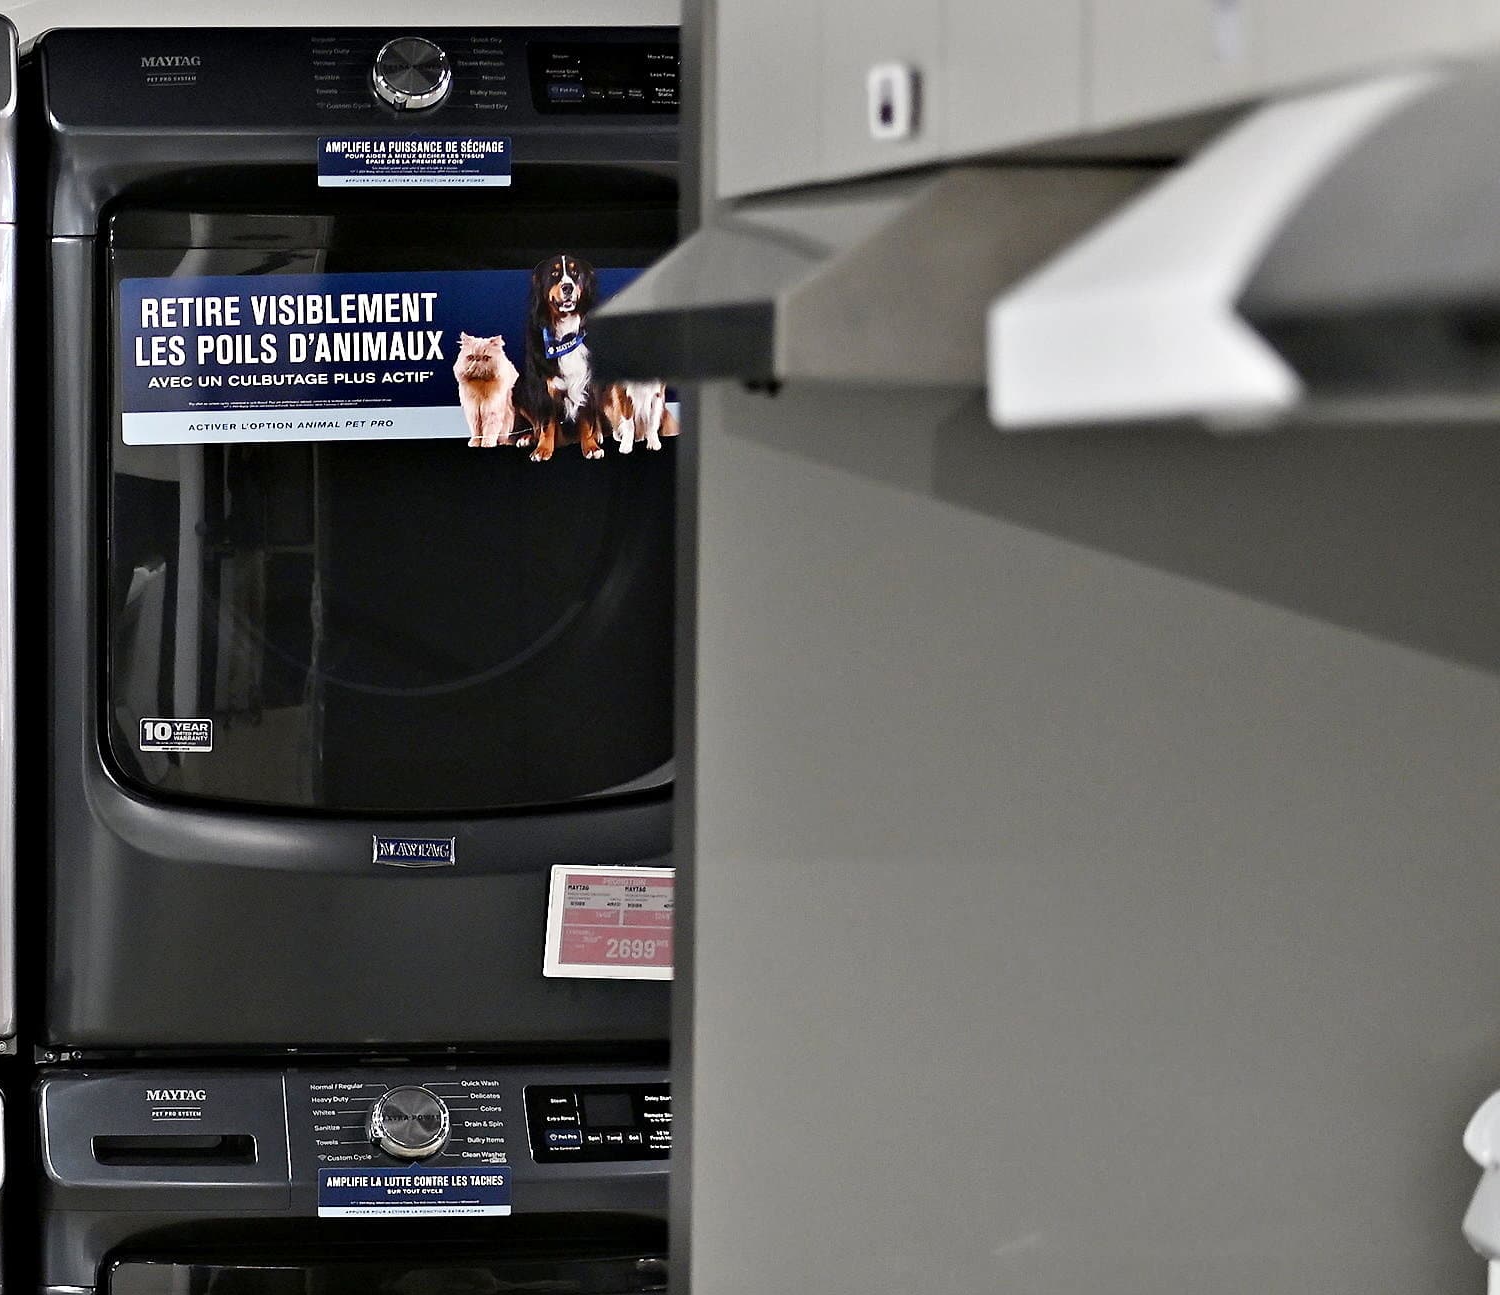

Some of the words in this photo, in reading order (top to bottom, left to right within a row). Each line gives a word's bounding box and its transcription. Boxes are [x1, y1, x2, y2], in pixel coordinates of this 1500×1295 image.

[141, 56, 201, 67] MAYTAG
[326, 142, 370, 152] AMPLIFIE
[374, 142, 385, 152] LA
[389, 142, 442, 152] PUISSANCE
[446, 142, 457, 152] DE
[460, 139, 503, 152] SÉCHAGE
[141, 297, 242, 328] RETIRE
[250, 292, 438, 326] VISIBLEMENT
[136, 335, 186, 367] LES
[197, 334, 278, 365] POILS
[289, 330, 444, 363] D'ANIMAUX
[148, 375, 193, 388] AVEC
[198, 375, 222, 387] UN
[228, 373, 328, 386] CULBUTAGE
[333, 373, 376, 384] PLUS
[189, 423, 237, 431] ACTIVER
[241, 421, 293, 430] L'OPTION
[297, 420, 340, 429] ANIMAL
[345, 419, 365, 427] PET
[370, 419, 394, 427] PRO
[144, 722, 171, 740] 10
[174, 723, 208, 731] YEAR
[380, 843, 450, 858] MAYTAG
[606, 939, 655, 958] 2699
[146, 1090, 206, 1100] MAYTAG
[327, 1177, 368, 1187] AMPLIFIE
[370, 1177, 382, 1187] LA
[384, 1177, 411, 1186] LUTTE
[414, 1176, 449, 1186] CONTRE
[452, 1176, 467, 1186] LES
[470, 1175, 503, 1186] TACHES
